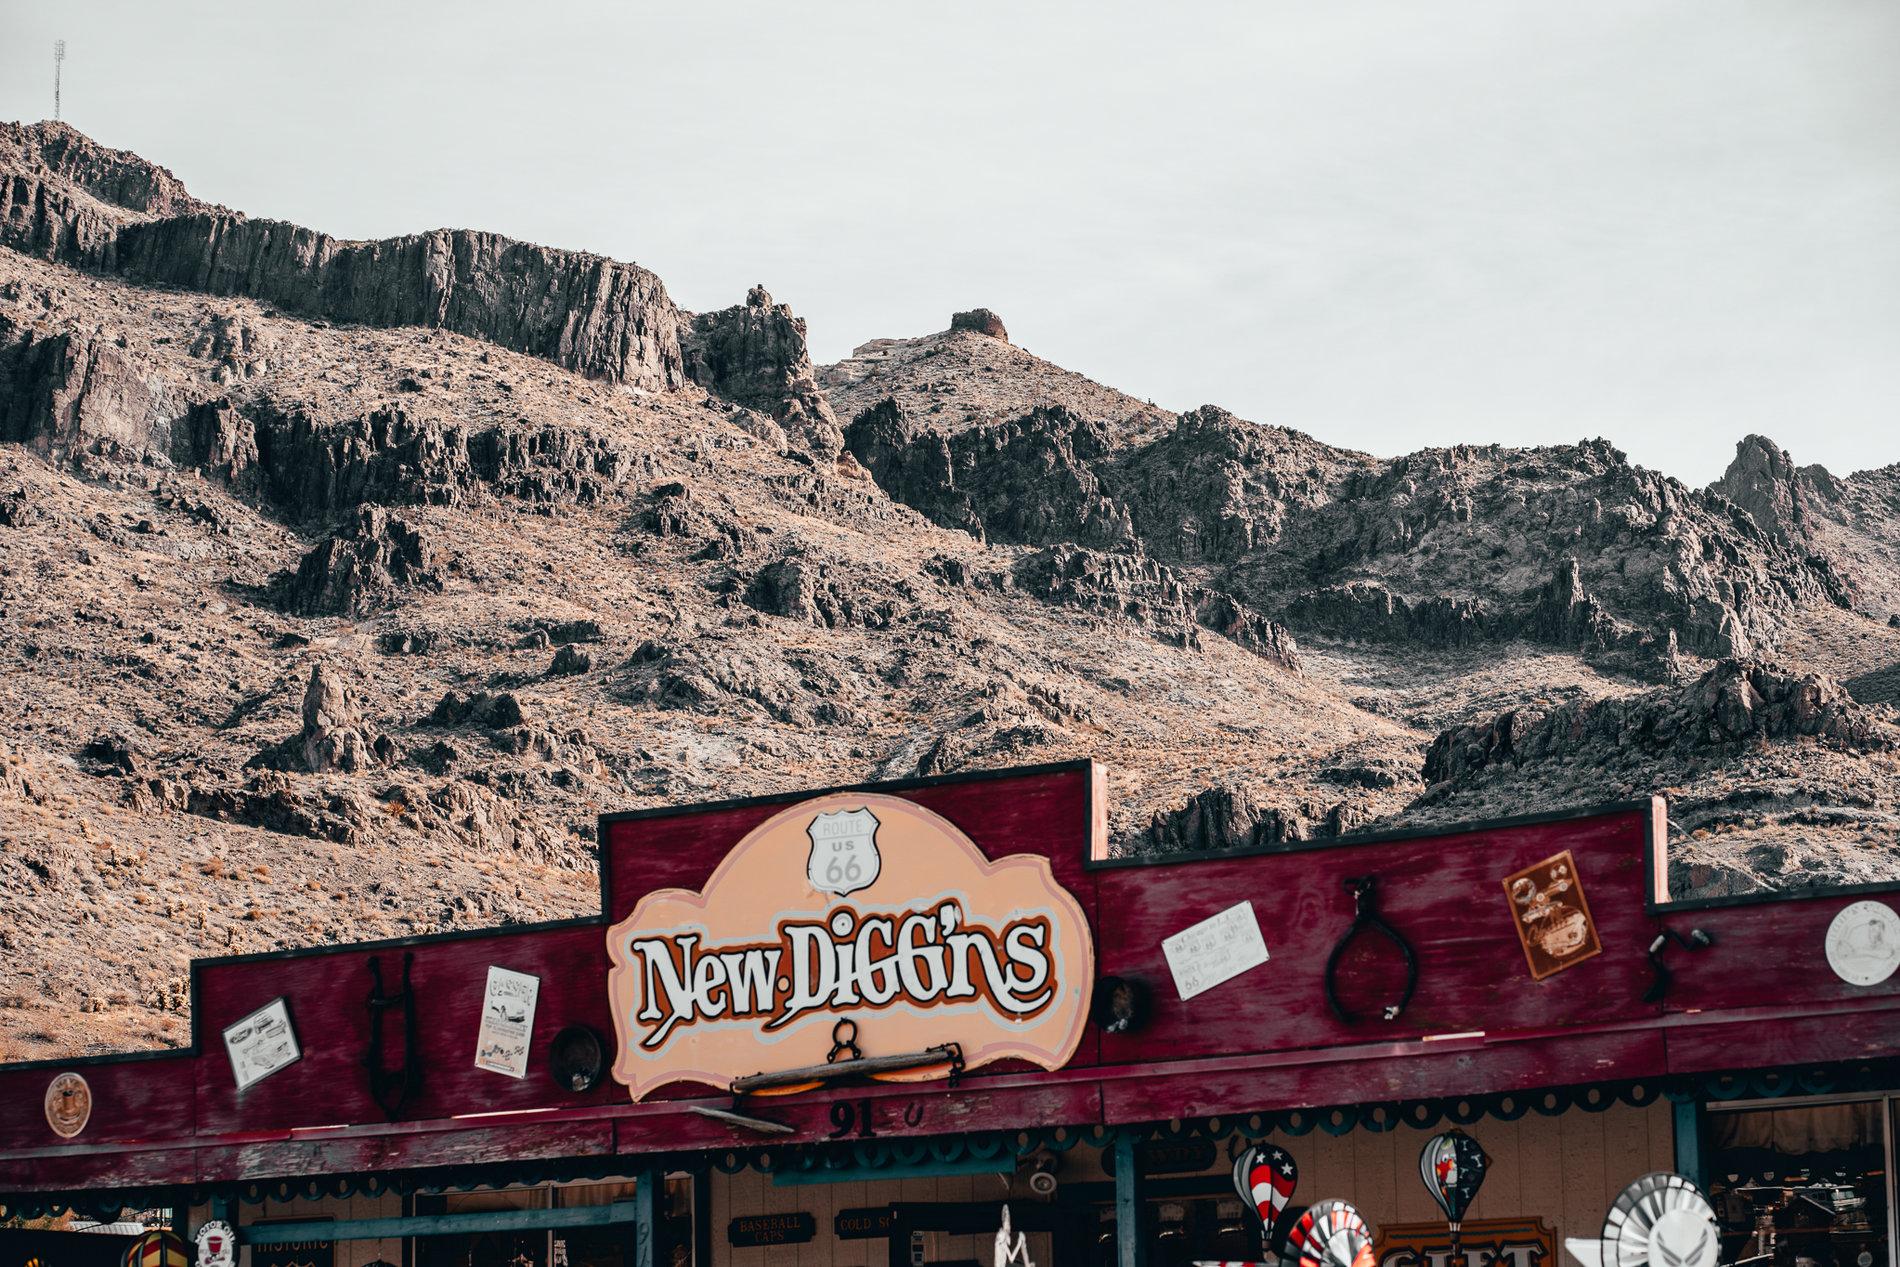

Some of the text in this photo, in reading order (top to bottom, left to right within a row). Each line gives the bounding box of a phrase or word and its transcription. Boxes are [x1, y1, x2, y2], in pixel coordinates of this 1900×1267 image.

[822, 817, 863, 836] ROUTE
[831, 840, 855, 852] US
[826, 855, 862, 884] 66
[829, 1099, 875, 1138] 91
[739, 1216, 801, 1233] BASEBALL
[840, 1217, 872, 1231] COLD
[755, 1231, 785, 1242] CAPS
